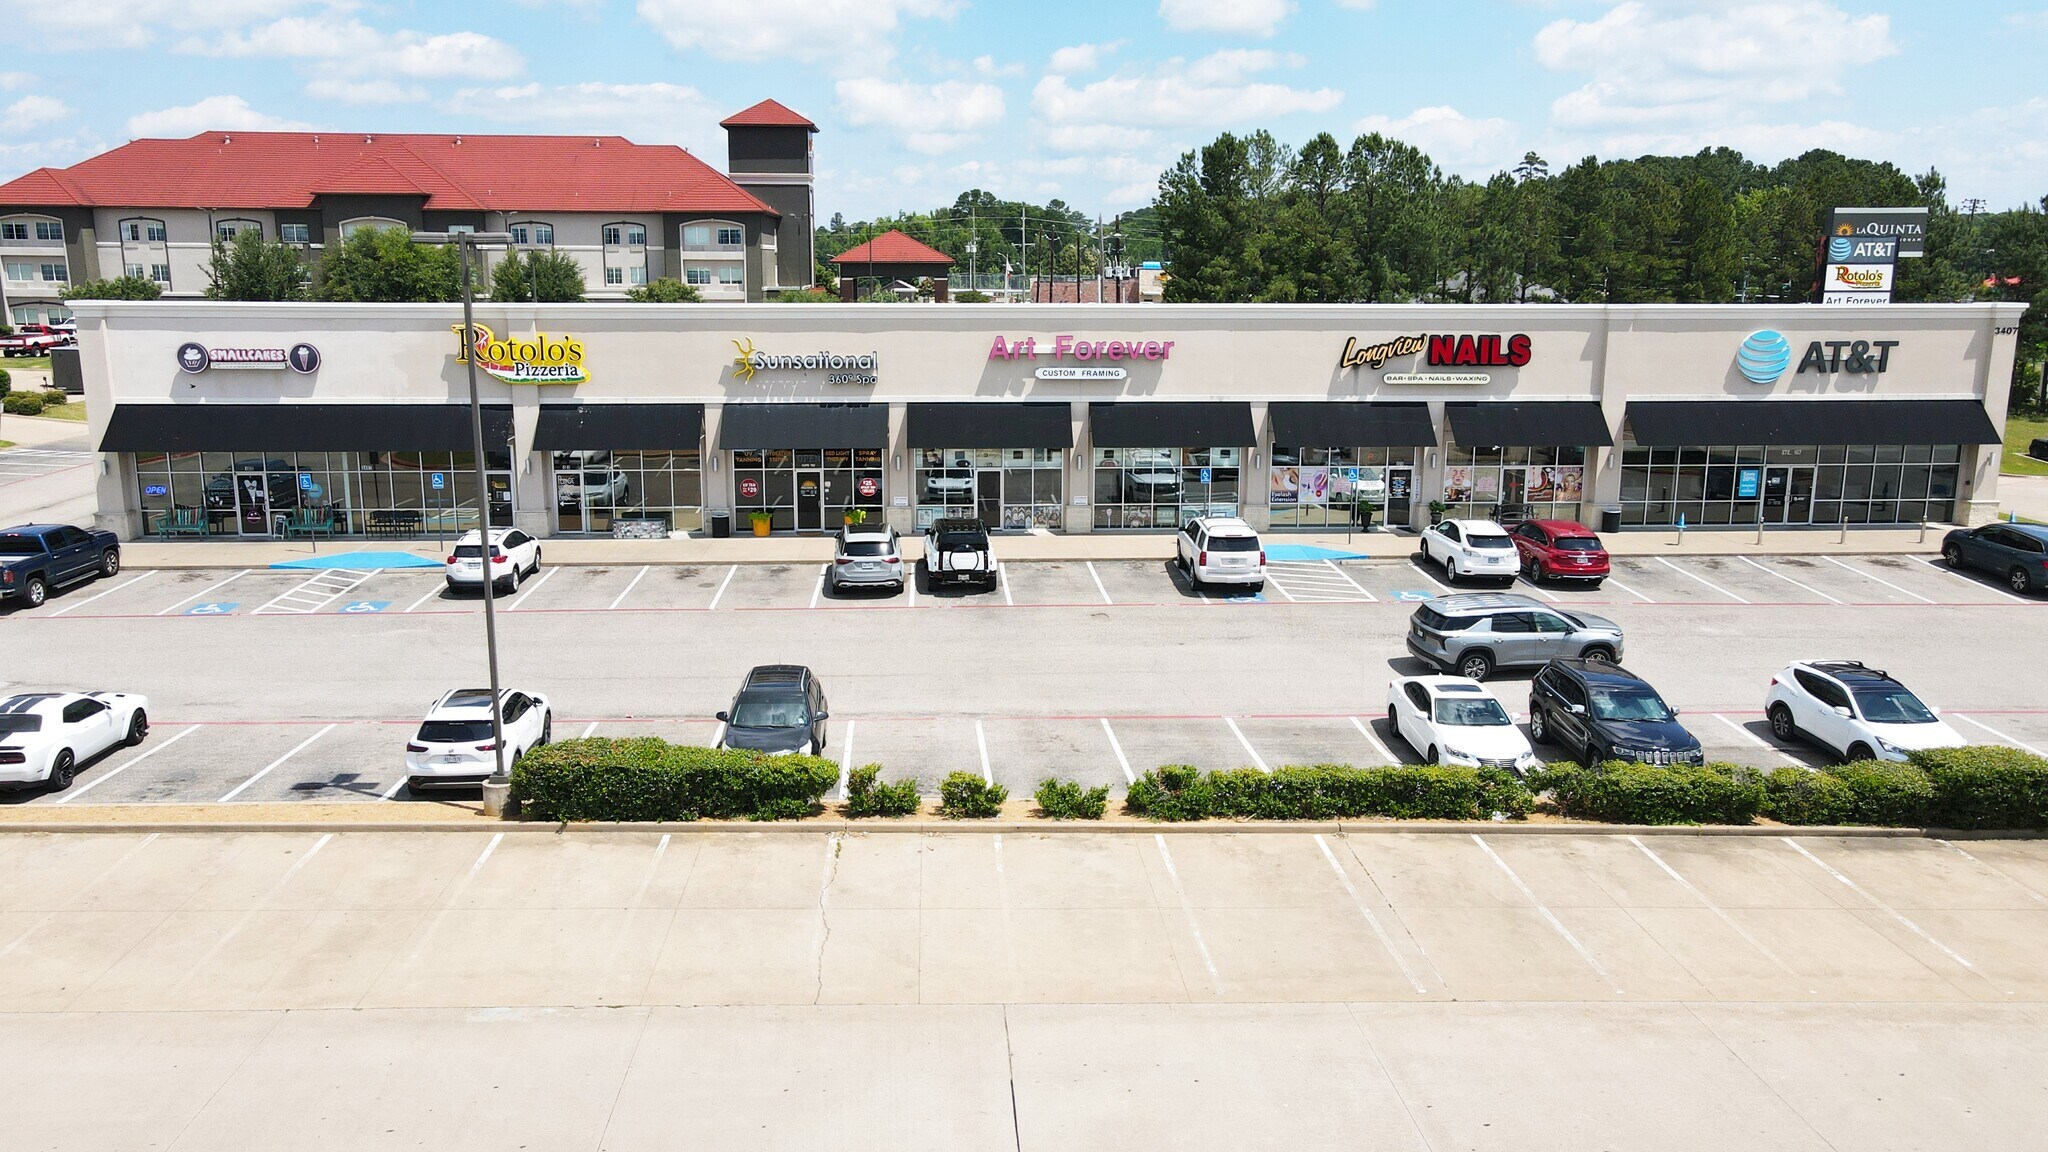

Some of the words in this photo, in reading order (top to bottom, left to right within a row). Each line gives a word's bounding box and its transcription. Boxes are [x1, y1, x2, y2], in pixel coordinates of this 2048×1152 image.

[1853, 242, 1896, 257] AT&T
[1835, 265, 1883, 281] Rotolo's
[1994, 326, 2019, 335] 3407
[454, 325, 582, 361] Rotolo's
[988, 335, 1036, 360] Art
[1055, 335, 1175, 361] Forever
[209, 349, 287, 361] SMALLCAKES
[1340, 333, 1427, 369] Longview
[1428, 334, 1532, 367] NAILS
[1797, 340, 1899, 374] AT&T
[755, 351, 878, 370] Sunsational
[514, 362, 579, 376] Pizzeria
[1042, 369, 1076, 377] CUSTOM
[1081, 369, 1120, 377] FRAMING
[856, 374, 879, 385] Spa
[145, 486, 167, 494] OPEN
